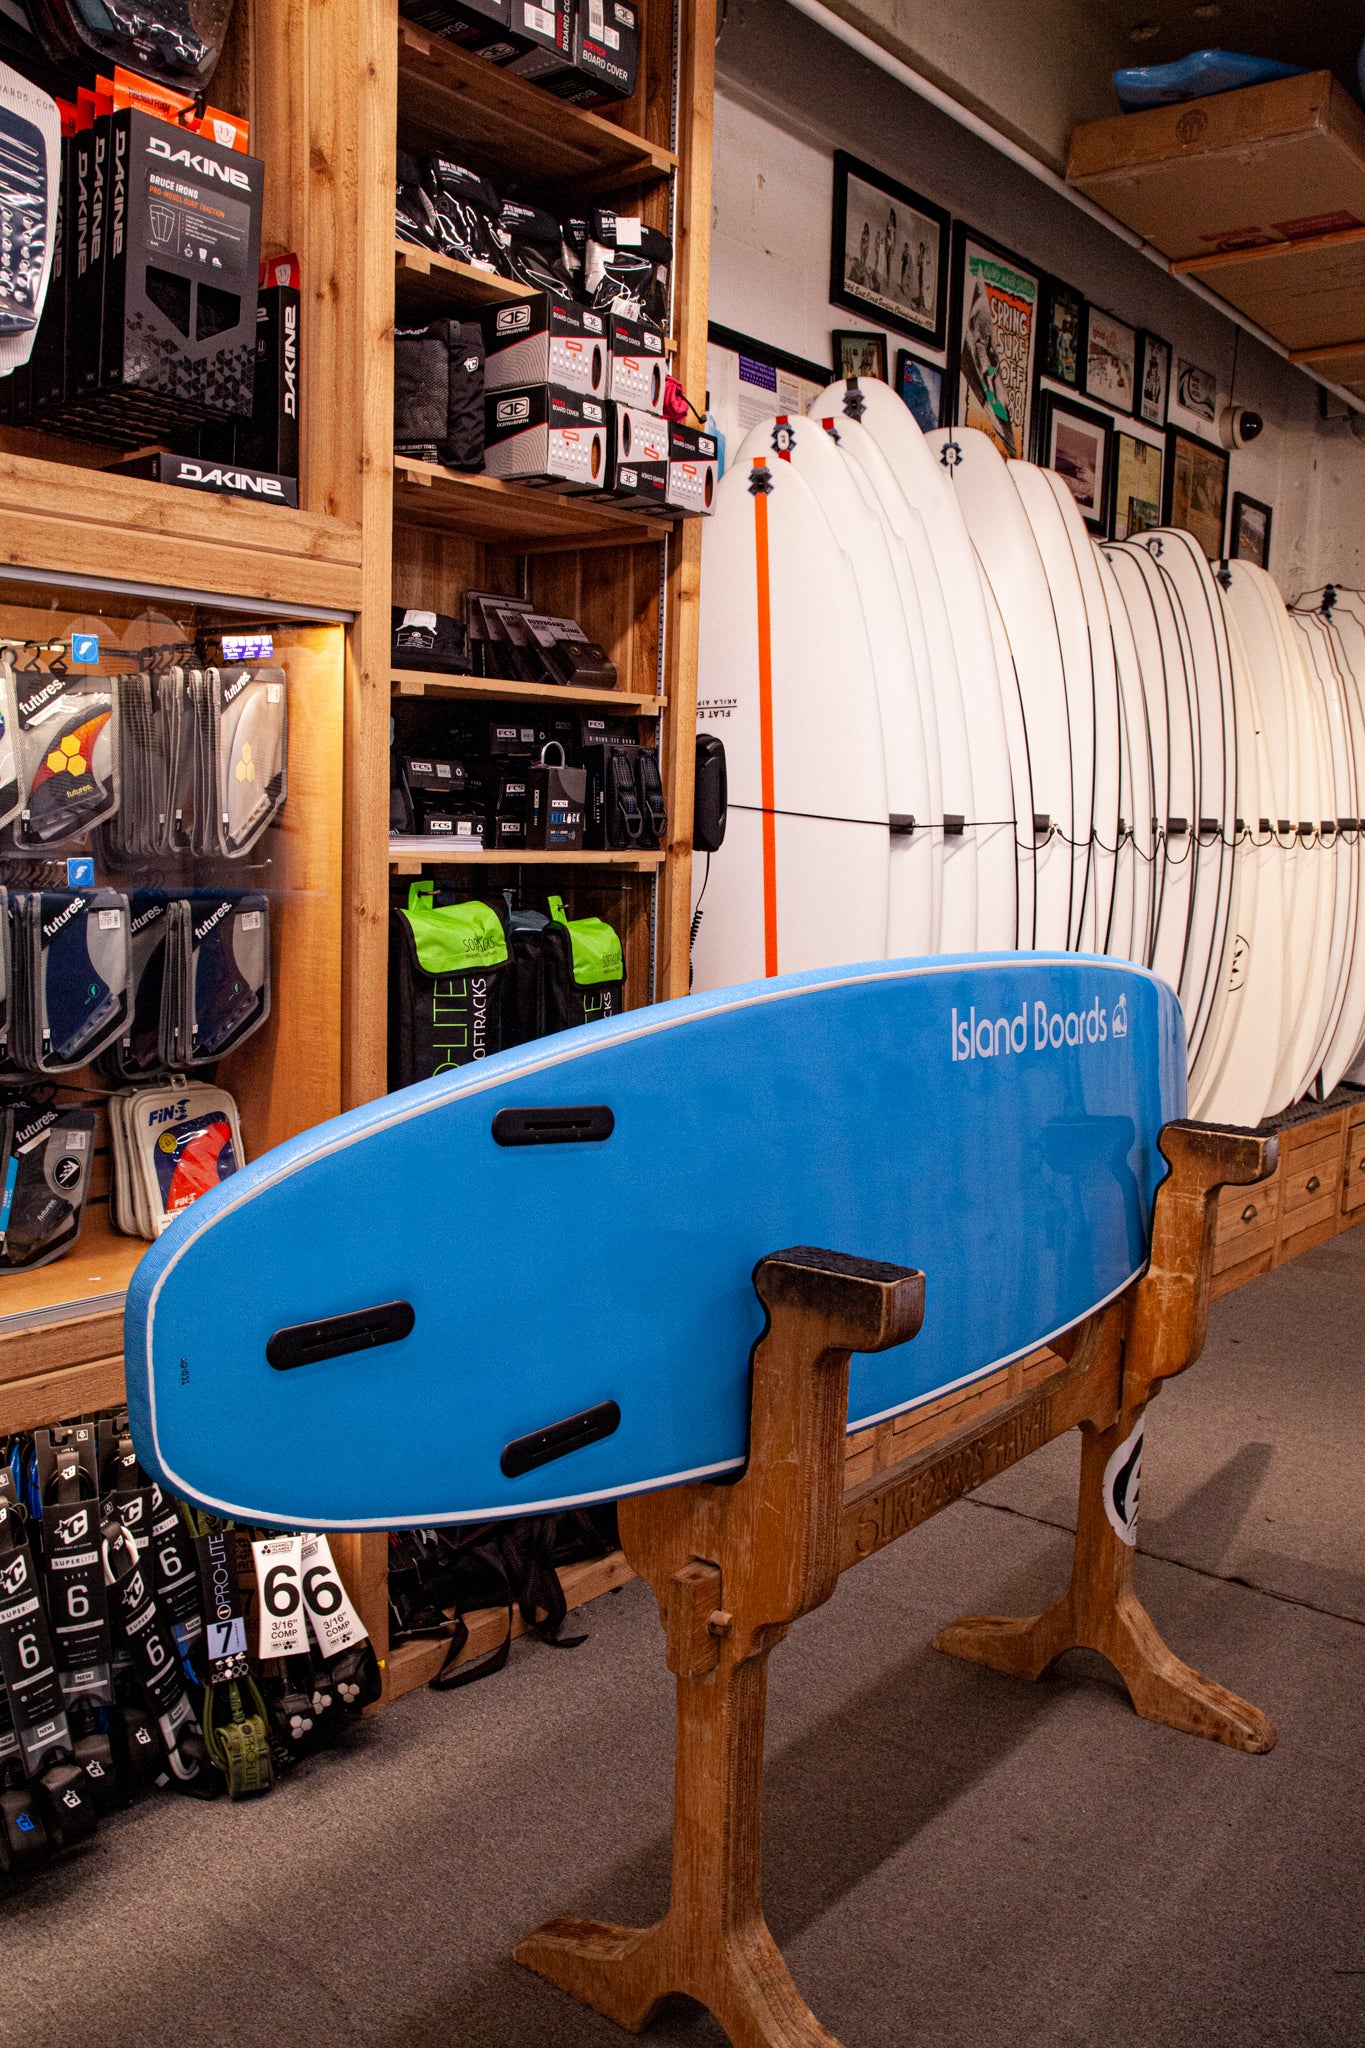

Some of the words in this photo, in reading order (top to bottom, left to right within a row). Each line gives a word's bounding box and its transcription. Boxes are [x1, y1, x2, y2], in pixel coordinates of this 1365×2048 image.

[562, 13, 572, 51] BOARD
[583, 50, 606, 69] BOARD
[606, 62, 628, 81] COVER
[0, 84, 55, 113] ARDS.COM
[145, 136, 252, 192] DAKINE
[90, 136, 105, 265] DAKINE
[112, 128, 126, 260] DAKINE
[149, 173, 175, 191] BRUCE
[175, 183, 199, 200] IRONS
[77, 149, 89, 279] DAKINE
[990, 296, 1028, 336] SPRING
[996, 327, 1027, 361] SURF
[284, 304, 297, 420] DAKINE
[999, 358, 1024, 389] OFF
[177, 462, 286, 498] DAKINE
[18, 678, 66, 716] futures.
[708, 709, 731, 719] FLAT
[412, 763, 431, 771] FCS
[432, 821, 451, 829] FCS
[43, 896, 86, 938] futures.
[194, 902, 233, 940] futures.
[952, 1002, 1028, 1062] Island
[1034, 995, 1108, 1051] Boards
[15, 1109, 59, 1143] futures.
[54, 1554, 95, 1567] SUPERLITE
[64, 1571, 89, 1581] LITE
[158, 1547, 182, 1577] 6
[208, 1533, 231, 1606] PRO-LITE
[67, 1585, 89, 1618] 6
[264, 1565, 300, 1618] 6
[302, 1565, 343, 1617] 6
[1, 1601, 38, 1621] SUPERLITE
[10, 1618, 37, 1633] COMP
[187, 1617, 201, 1630] NEW
[216, 1621, 233, 1654] 7
[271, 1628, 298, 1640] COMP
[326, 1621, 350, 1638] COMP
[18, 1633, 41, 1670] 6
[146, 1634, 165, 1667] 6
[76, 1671, 93, 1682] NEW
[173, 1704, 184, 1719] NEW
[1, 1735, 14, 1745] NEW
[39, 1723, 54, 1737] NEW
